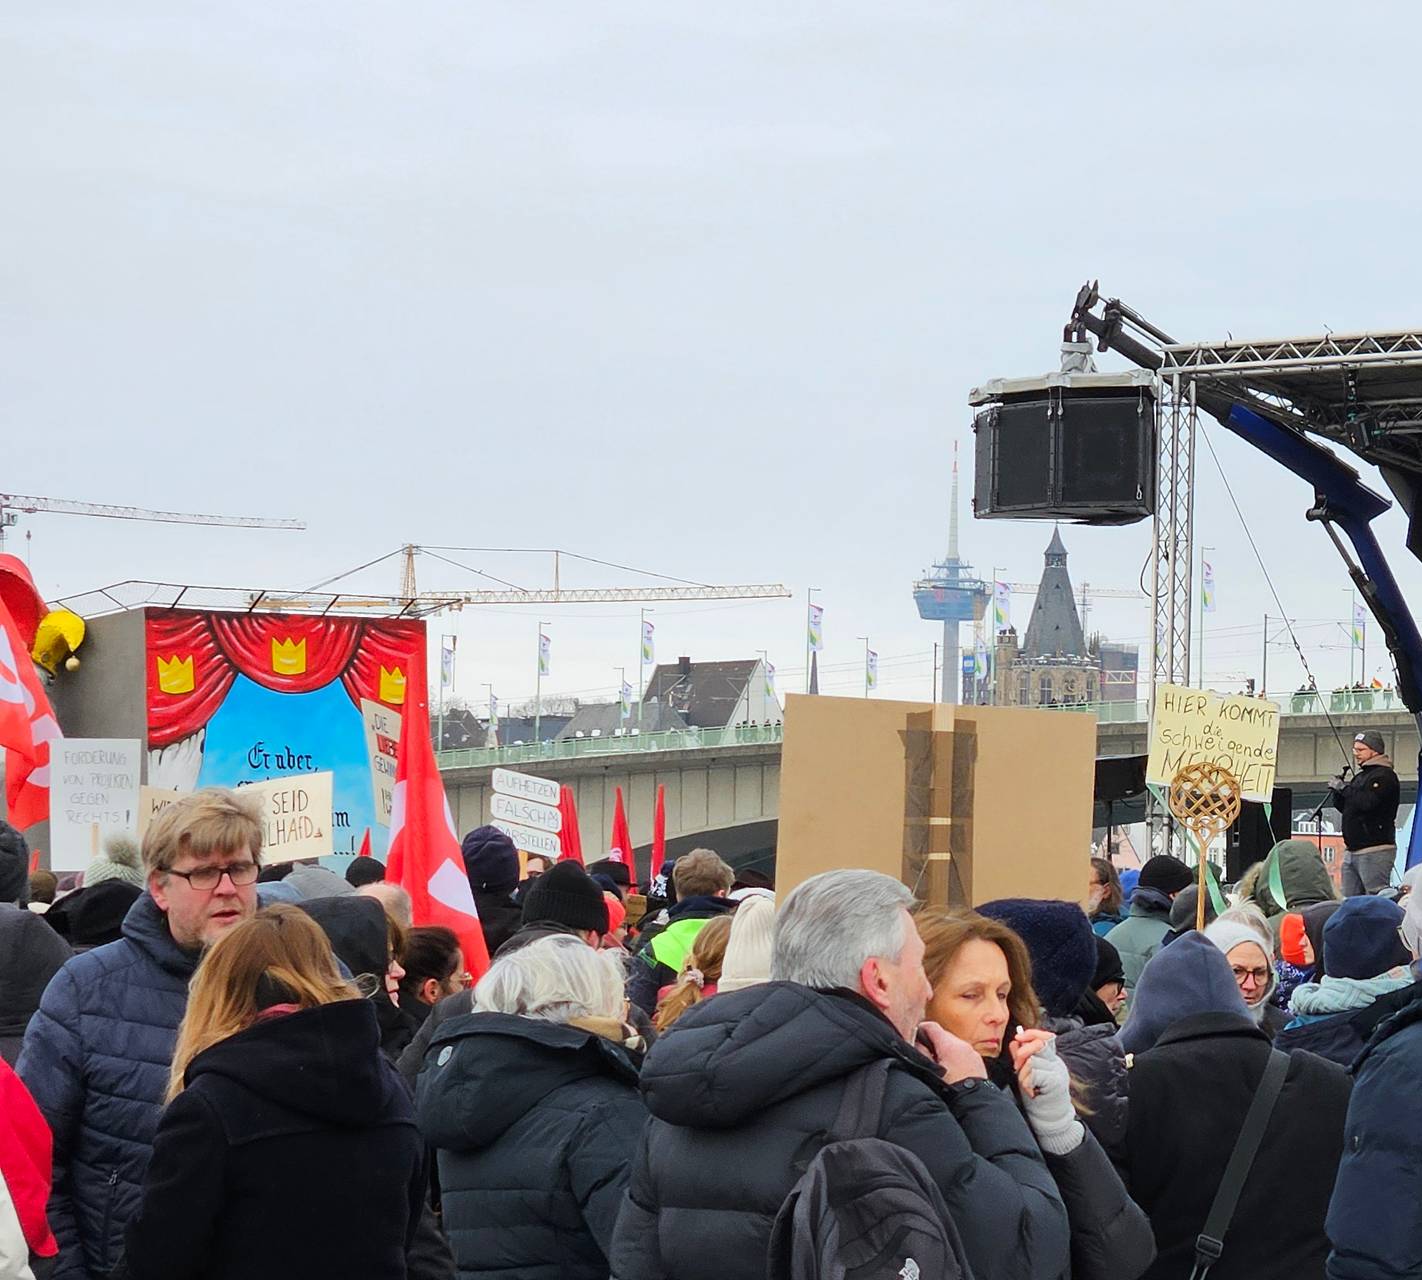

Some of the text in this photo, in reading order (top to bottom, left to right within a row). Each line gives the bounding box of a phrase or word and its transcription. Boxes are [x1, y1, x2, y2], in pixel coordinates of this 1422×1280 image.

[1164, 692, 1278, 727] HIER KOMMT
[1203, 720, 1222, 737] die
[70, 791, 109, 806] GEGEN
[496, 774, 557, 799] AUFHETZEN
[272, 789, 309, 815] SEID
[496, 798, 546, 826] FALSCH
